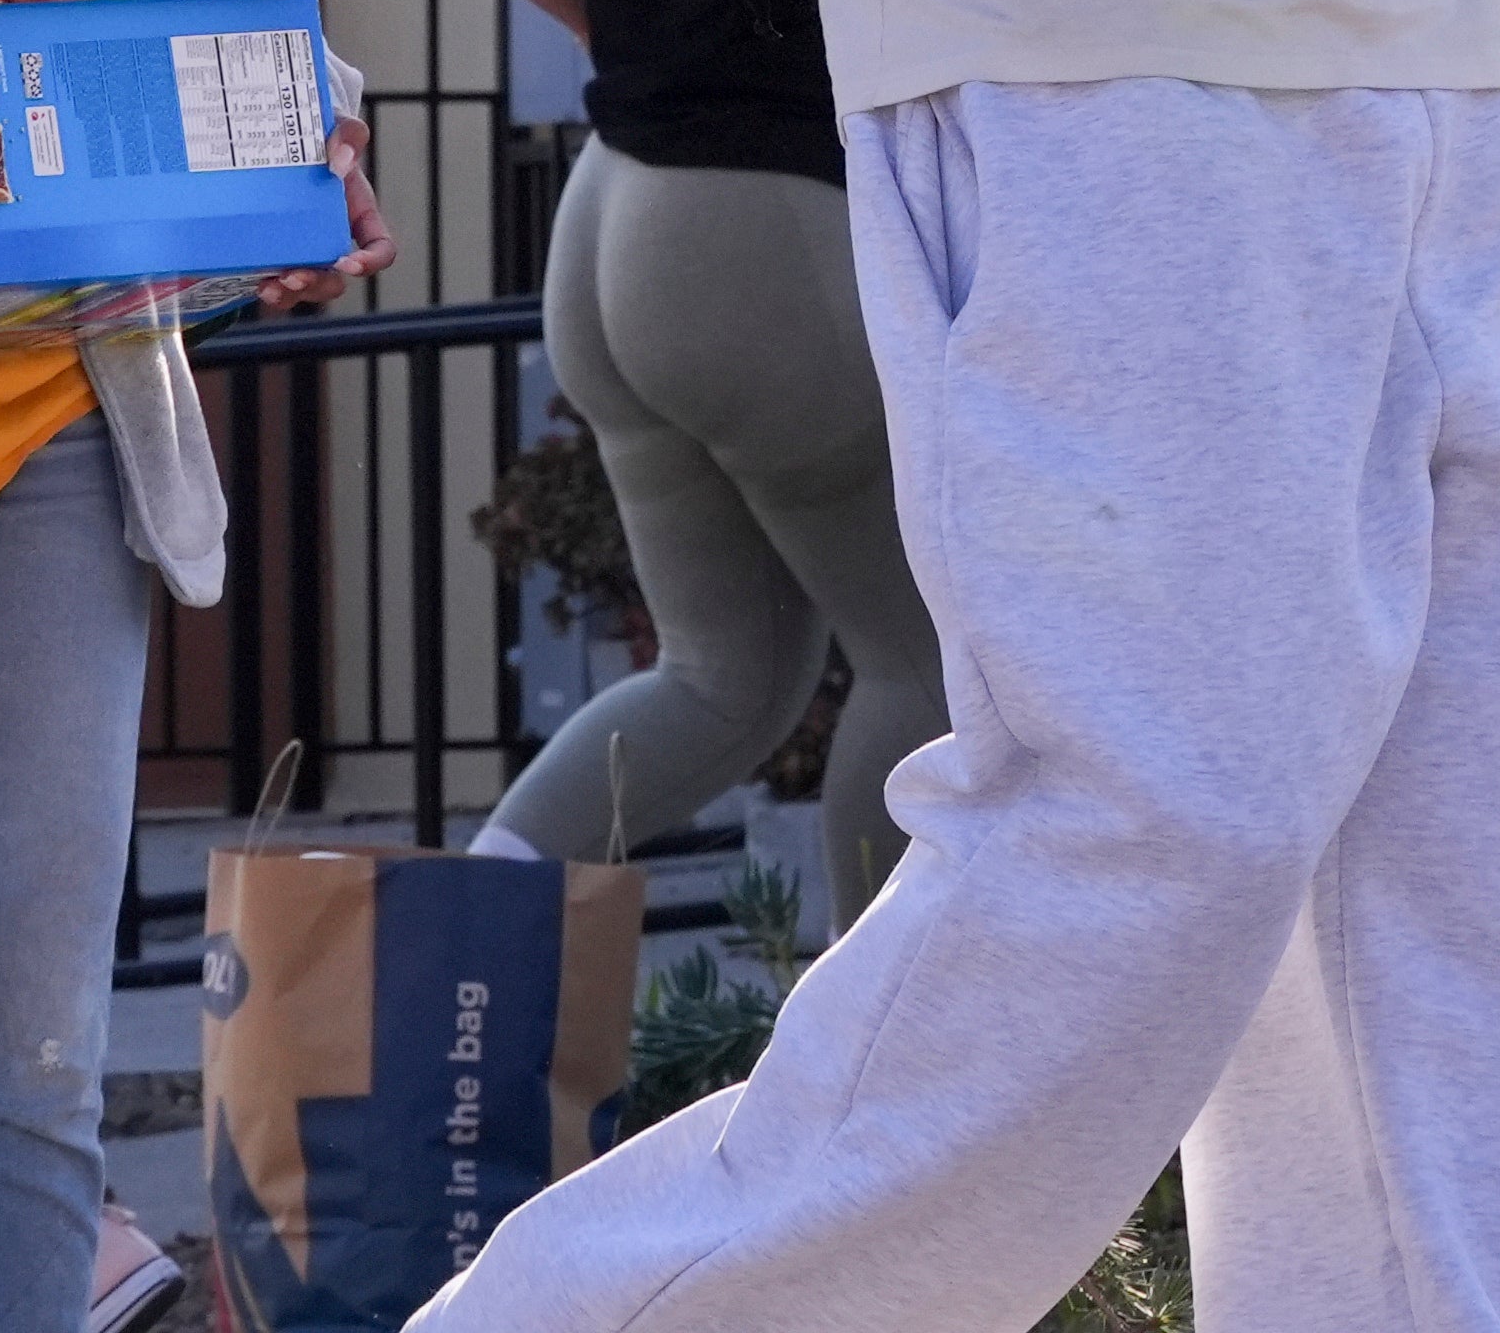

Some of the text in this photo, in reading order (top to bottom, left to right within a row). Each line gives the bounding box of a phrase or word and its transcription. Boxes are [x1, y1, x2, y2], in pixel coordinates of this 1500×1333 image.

[273, 32, 300, 164] Calories 130 130 130
[447, 980, 490, 1063] bag
[446, 1076, 482, 1144] the
[446, 1158, 478, 1199] in
